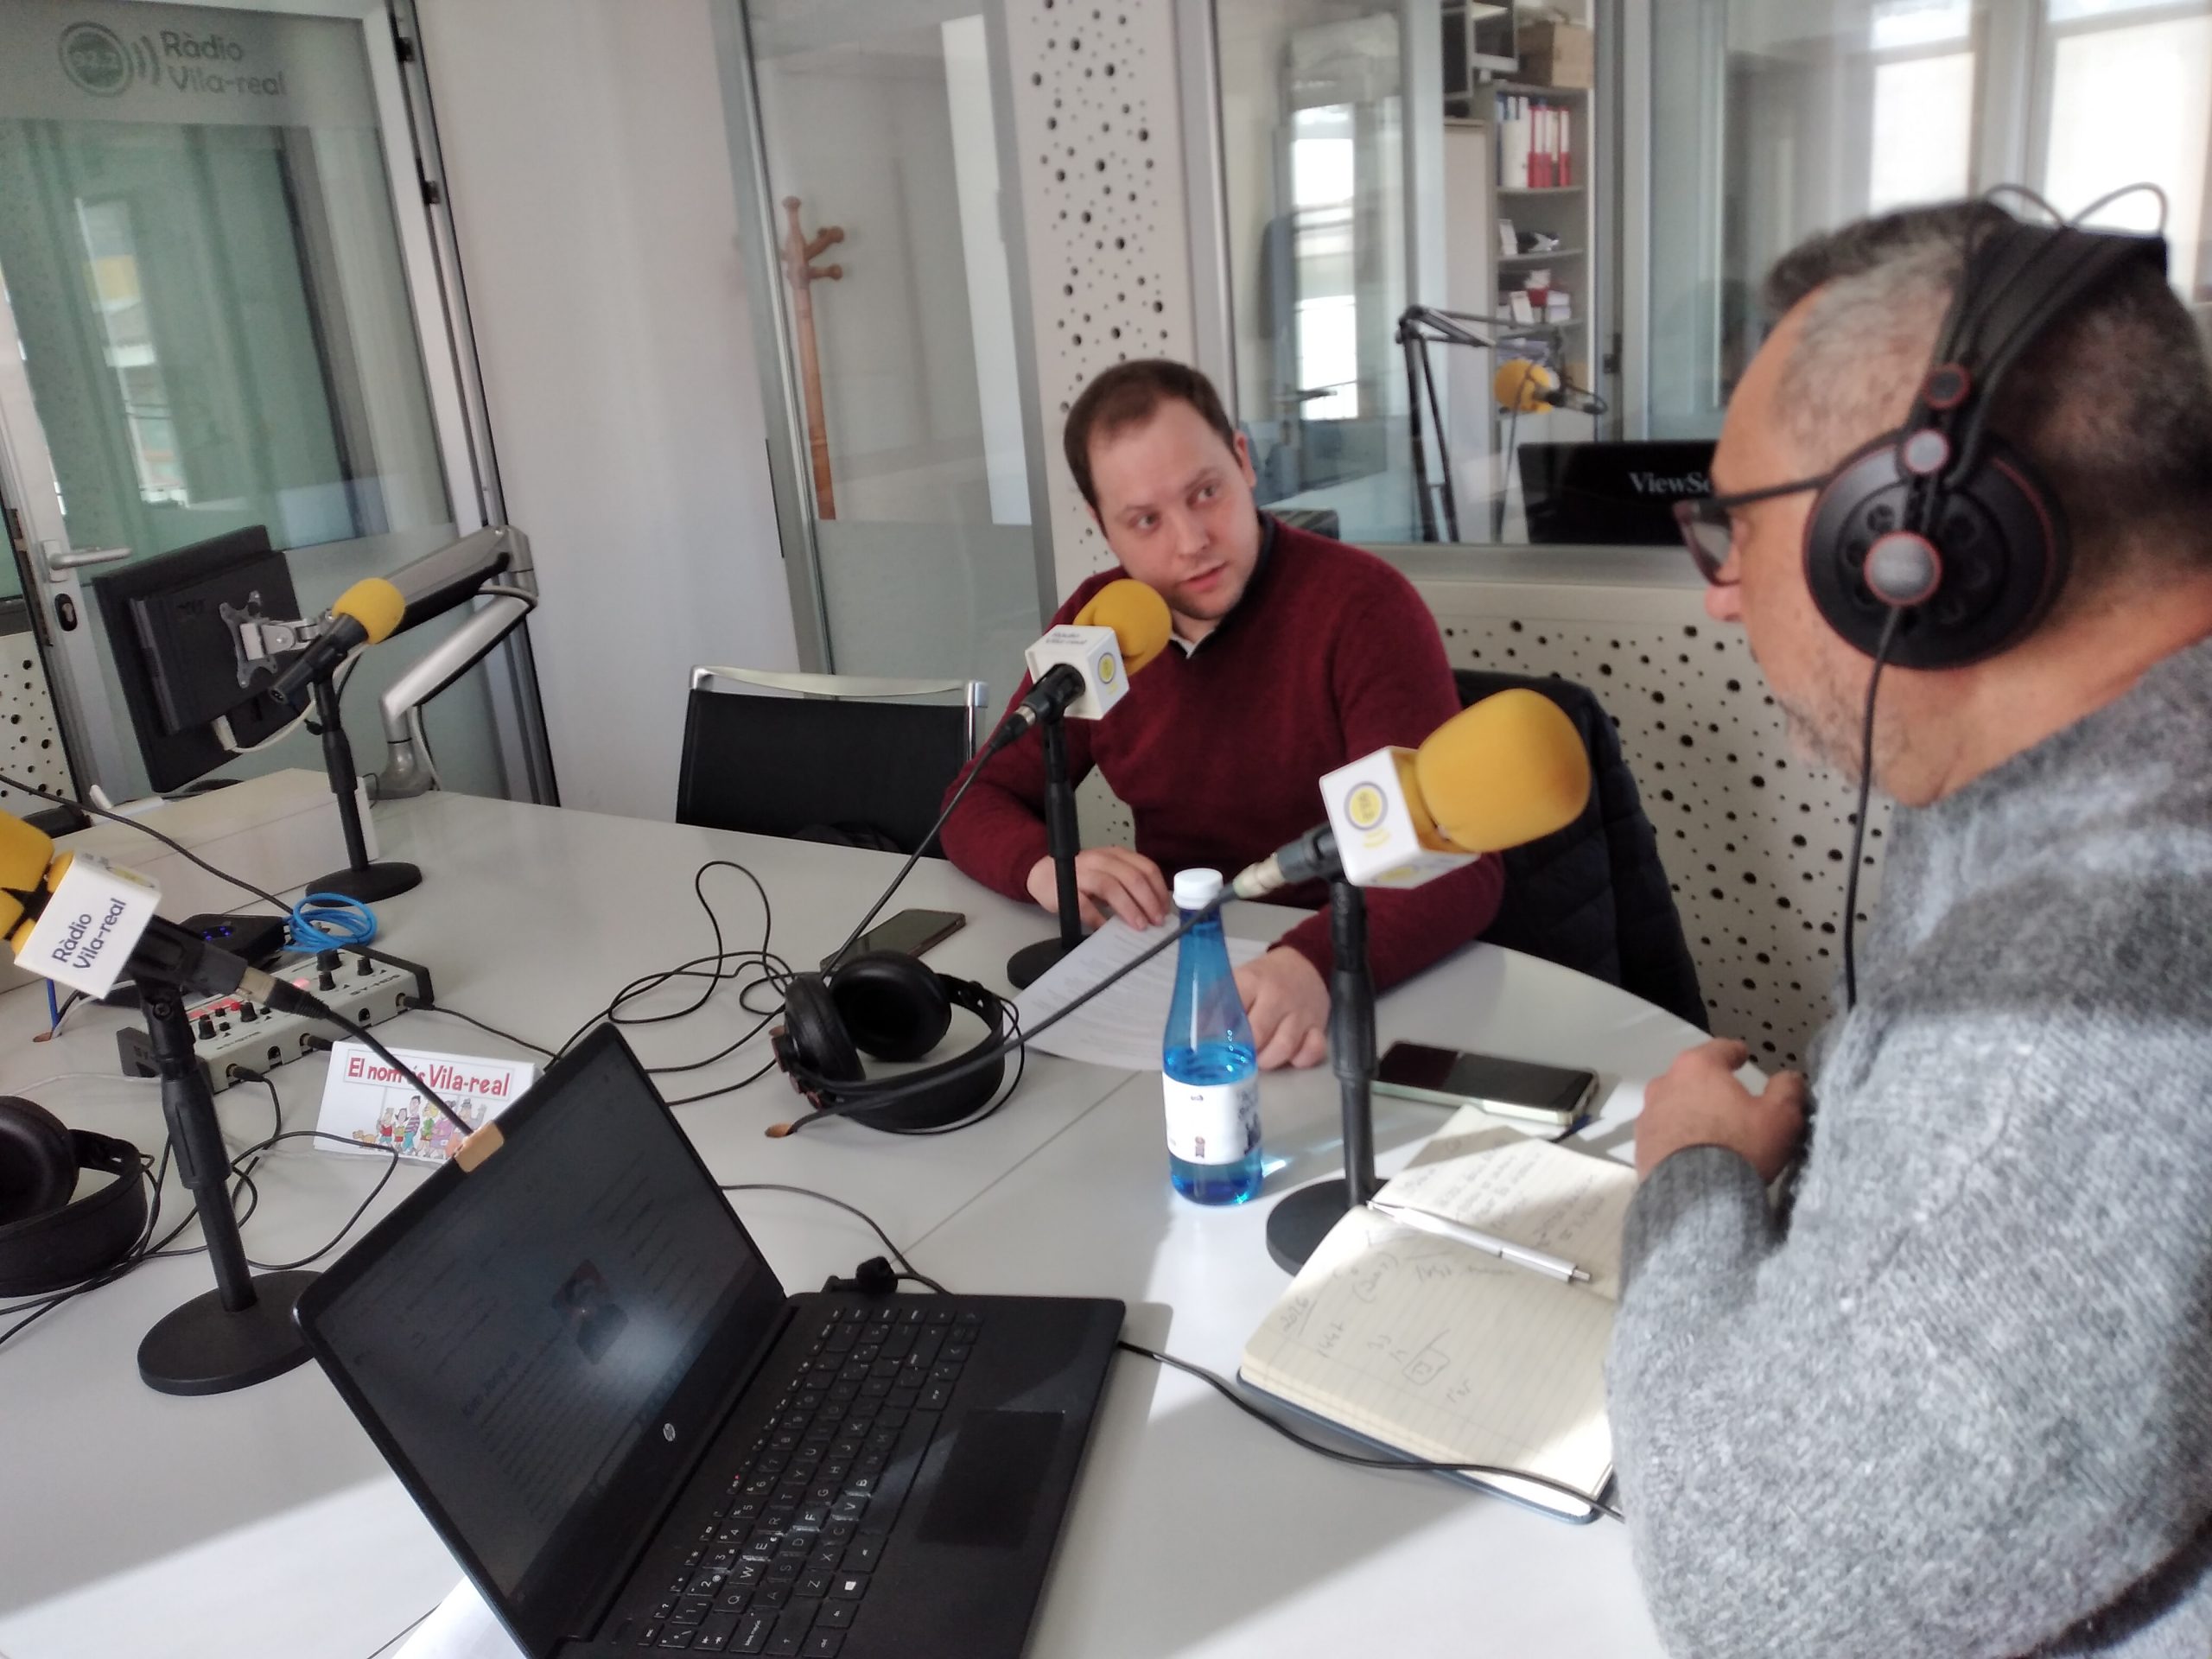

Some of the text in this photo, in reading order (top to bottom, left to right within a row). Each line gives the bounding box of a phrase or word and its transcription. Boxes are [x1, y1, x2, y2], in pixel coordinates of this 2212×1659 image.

[159, 29, 244, 61] Ràdio
[168, 65, 285, 96] Vila-real
[51, 913, 92, 963] Ràdio
[73, 897, 127, 969] Vila-real
[348, 1057, 365, 1077] El
[429, 1064, 510, 1096] Vila-real
